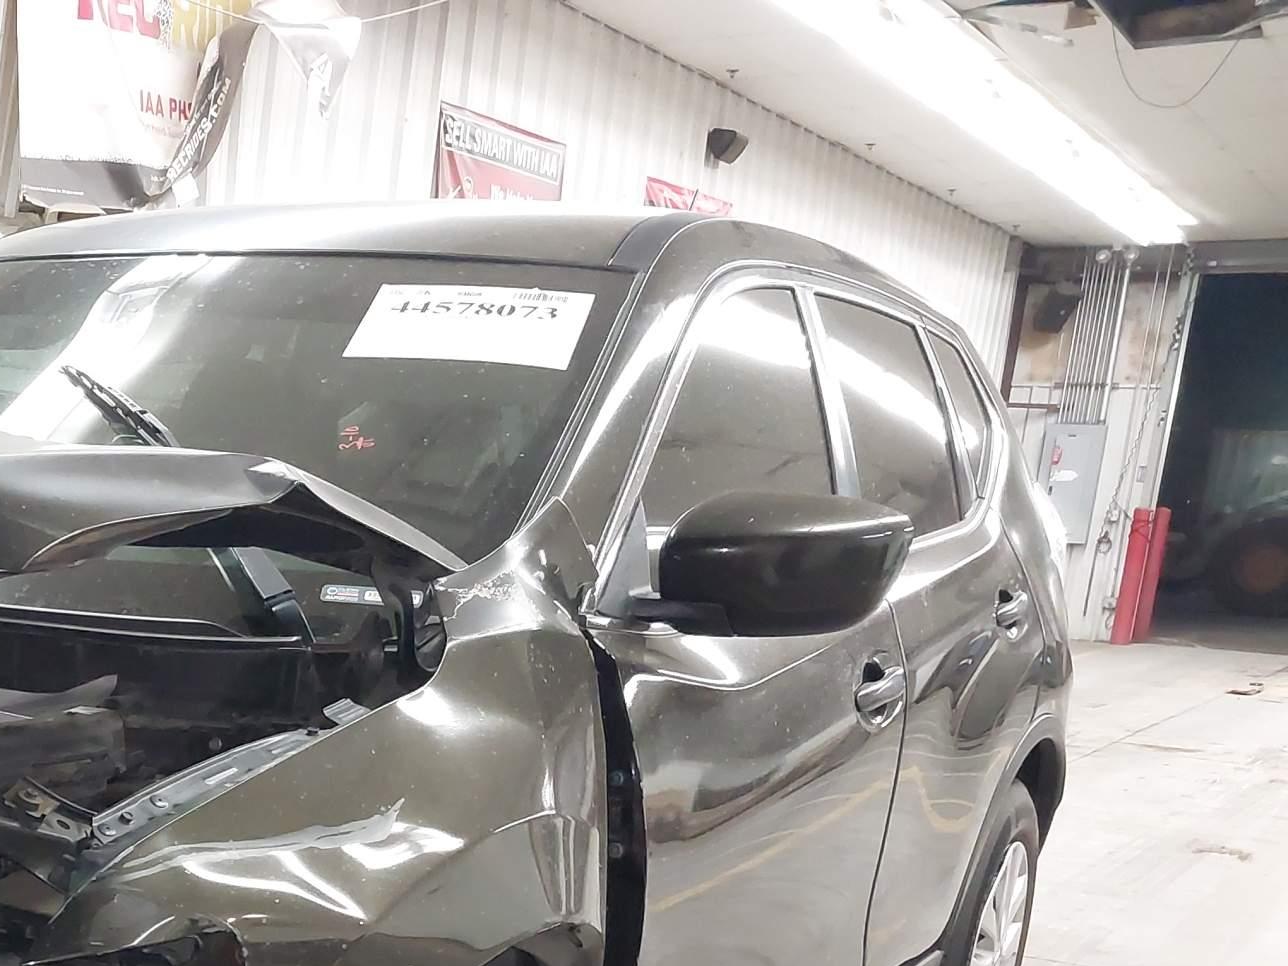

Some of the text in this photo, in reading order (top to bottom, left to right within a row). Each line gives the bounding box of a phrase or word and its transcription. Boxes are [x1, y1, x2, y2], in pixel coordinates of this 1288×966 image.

[139, 89, 165, 118] IAA
[166, 77, 231, 182] RECRIDES.COM
[473, 127, 511, 163] SMART
[391, 300, 559, 320] 44578073
